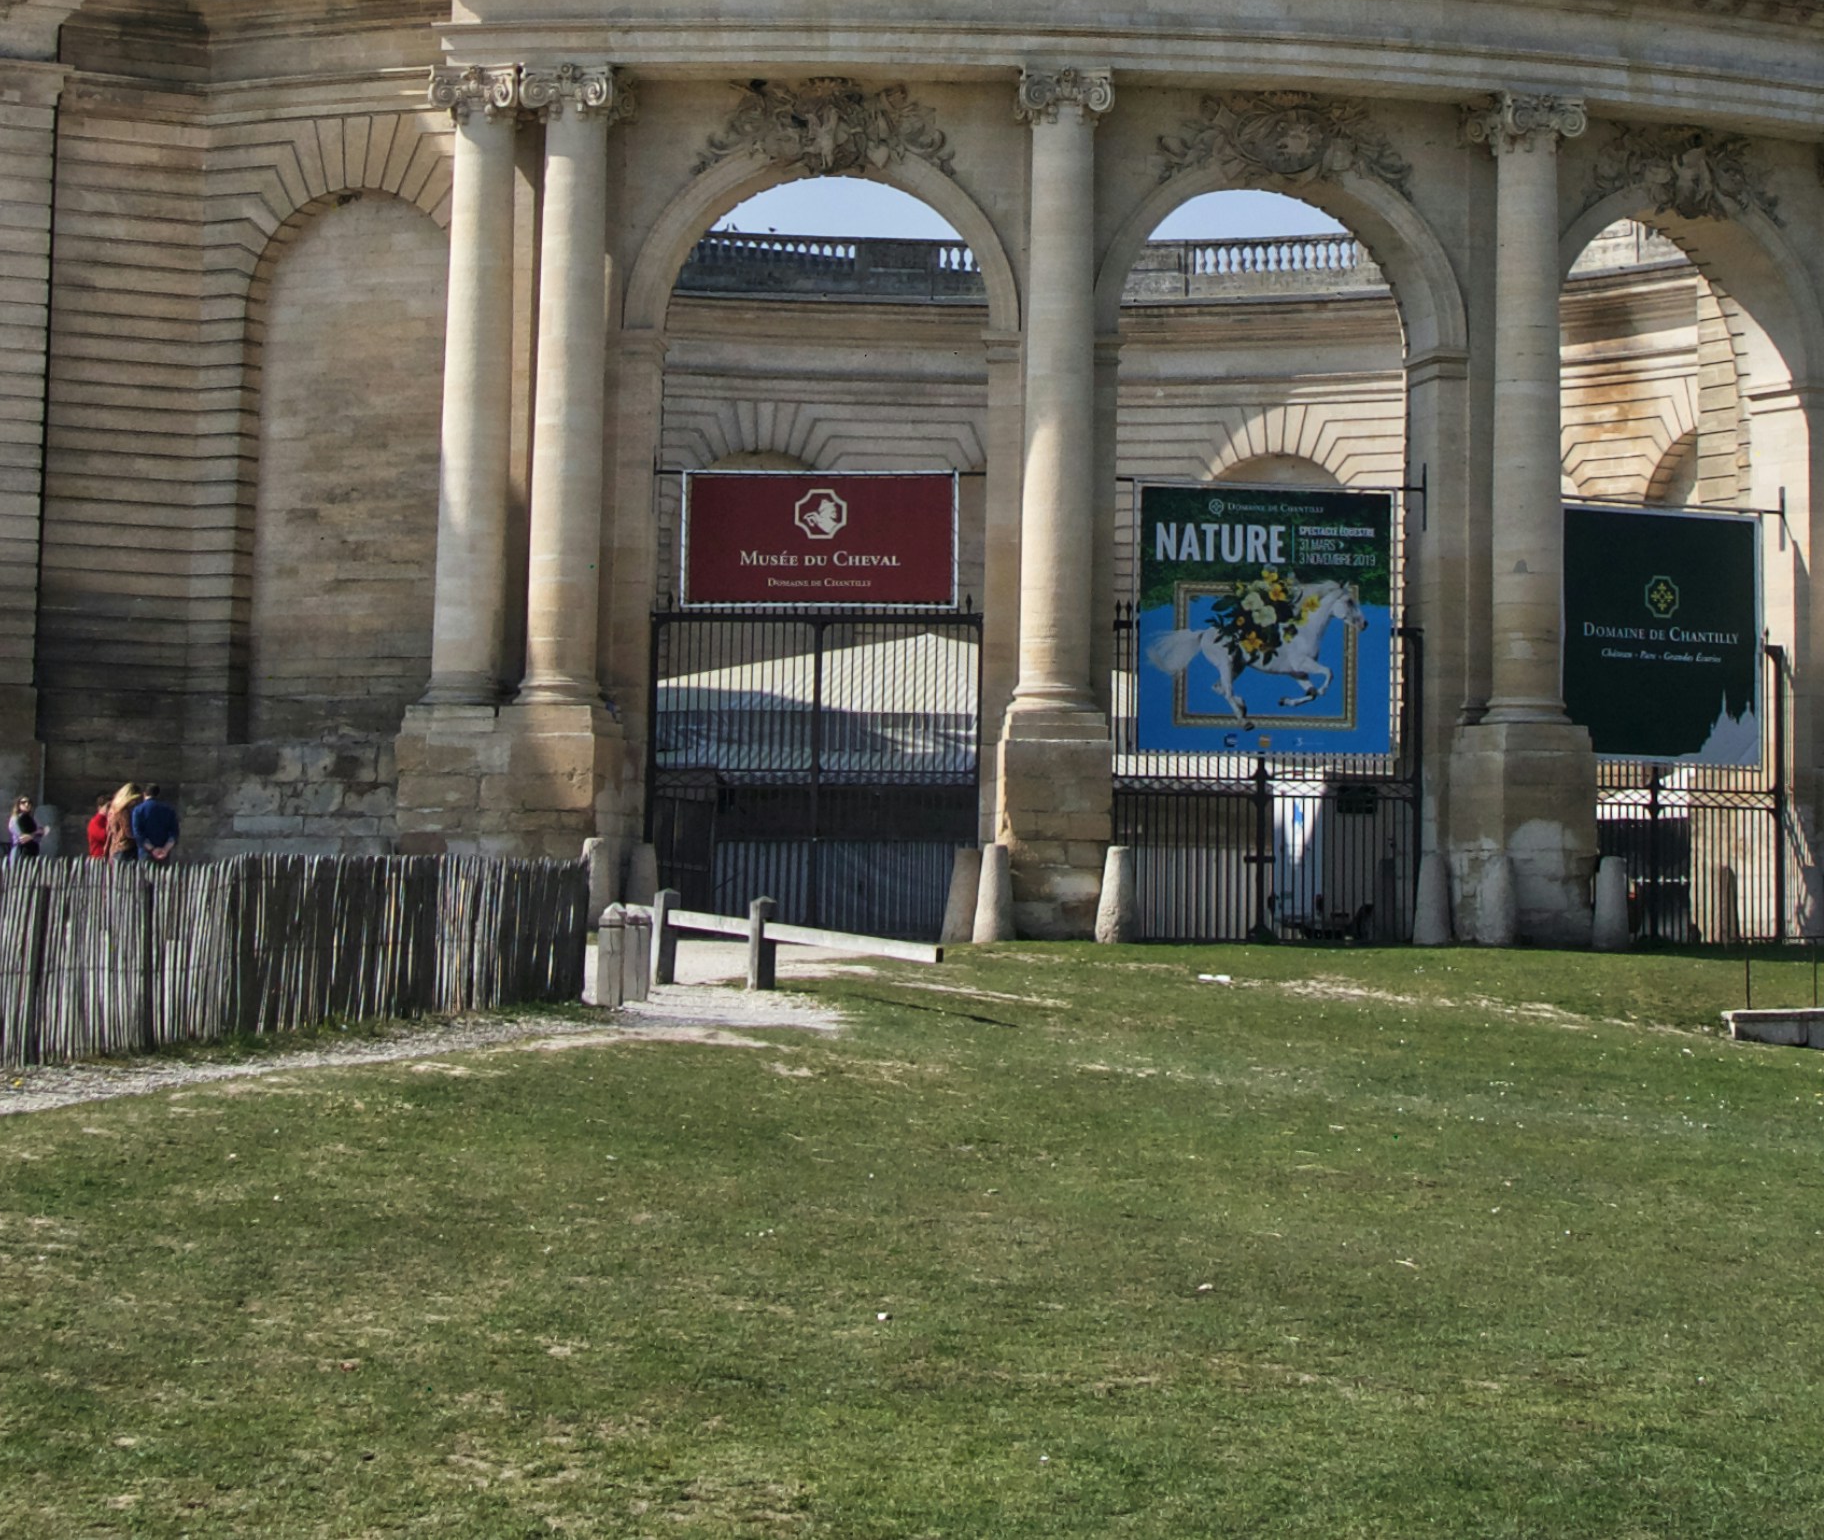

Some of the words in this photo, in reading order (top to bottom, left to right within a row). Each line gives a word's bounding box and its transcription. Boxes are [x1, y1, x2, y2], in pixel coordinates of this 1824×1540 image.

[1155, 521, 1286, 564] NATURE
[1298, 538, 1309, 551] 31
[1310, 538, 1336, 551] MARS
